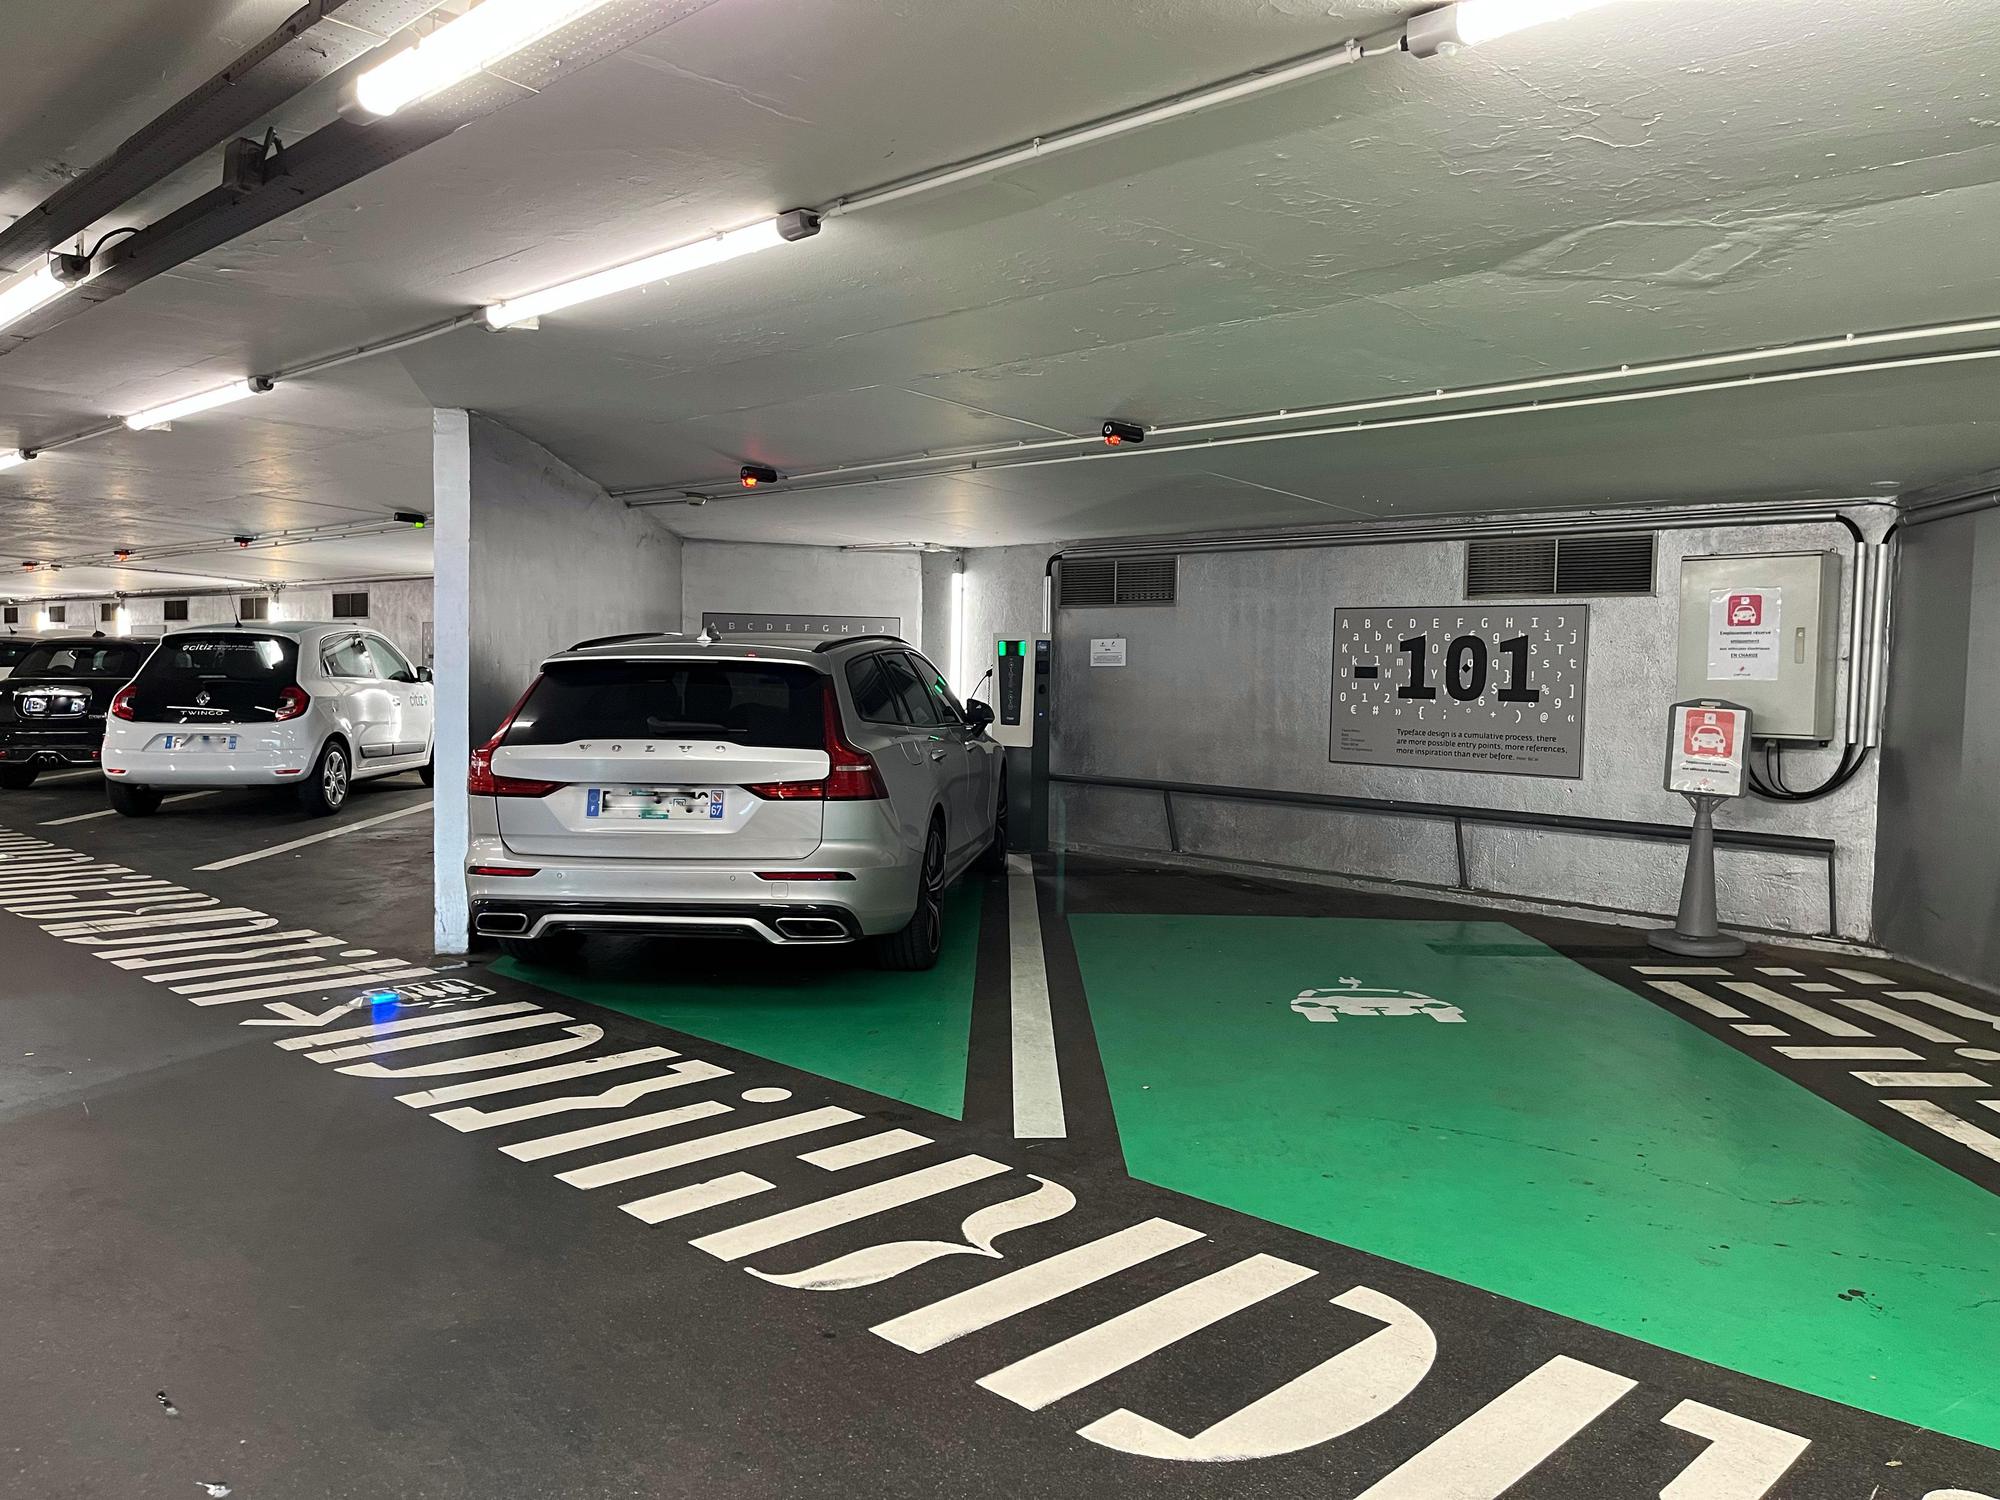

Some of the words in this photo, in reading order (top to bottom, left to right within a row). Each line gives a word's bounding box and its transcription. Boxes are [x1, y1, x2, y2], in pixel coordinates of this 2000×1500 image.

[710, 622, 717, 630] A
[728, 622, 736, 630] B
[766, 623, 773, 631] D
[785, 623, 791, 631] E
[822, 624, 830, 632] G
[841, 624, 848, 633] H
[861, 625, 866, 633] I
[879, 625, 885, 633] J
[1342, 618, 1349, 629] A
[1364, 618, 1371, 629] B
[1386, 618, 1393, 629] C
[1409, 618, 1416, 629] D
[1433, 618, 1440, 629] E
[1457, 617, 1464, 628] F
[1481, 617, 1489, 628] G
[1505, 617, 1513, 628] H
[1531, 617, 1539, 628] I
[1558, 617, 1565, 628] J
[1353, 633, 1360, 641] a
[1375, 630, 1382, 641] b
[1444, 633, 1451, 641] e
[1492, 632, 1500, 644] g
[1544, 630, 1551, 641] i
[1569, 629, 1577, 644] j
[1341, 643, 1349, 654] K
[1364, 643, 1370, 653] L
[1385, 643, 1393, 653] M
[1530, 644, 1538, 655] S
[1556, 644, 1564, 655] T
[1396, 658, 1404, 666] m
[1492, 658, 1499, 670] q
[1569, 658, 1577, 669] t
[1340, 667, 1347, 678] U
[1384, 668, 1392, 679] W
[1431, 669, 1438, 679] Y
[1361, 693, 1368, 703] 1
[1383, 693, 1390, 704] 2
[1554, 698, 1562, 709] 9
[1372, 705, 1379, 716] #
[1540, 712, 1549, 723] @
[1397, 728, 1426, 737] Typeface
[1427, 730, 1450, 738] design
[1464, 732, 1504, 740] cumulative
[1536, 735, 1557, 743] there
[579, 744, 727, 753] VOLVO
[1457, 741, 1476, 749] entry
[1526, 744, 1568, 754] references,
[1489, 752, 1516, 761] before.
[711, 804, 722, 815] 67
